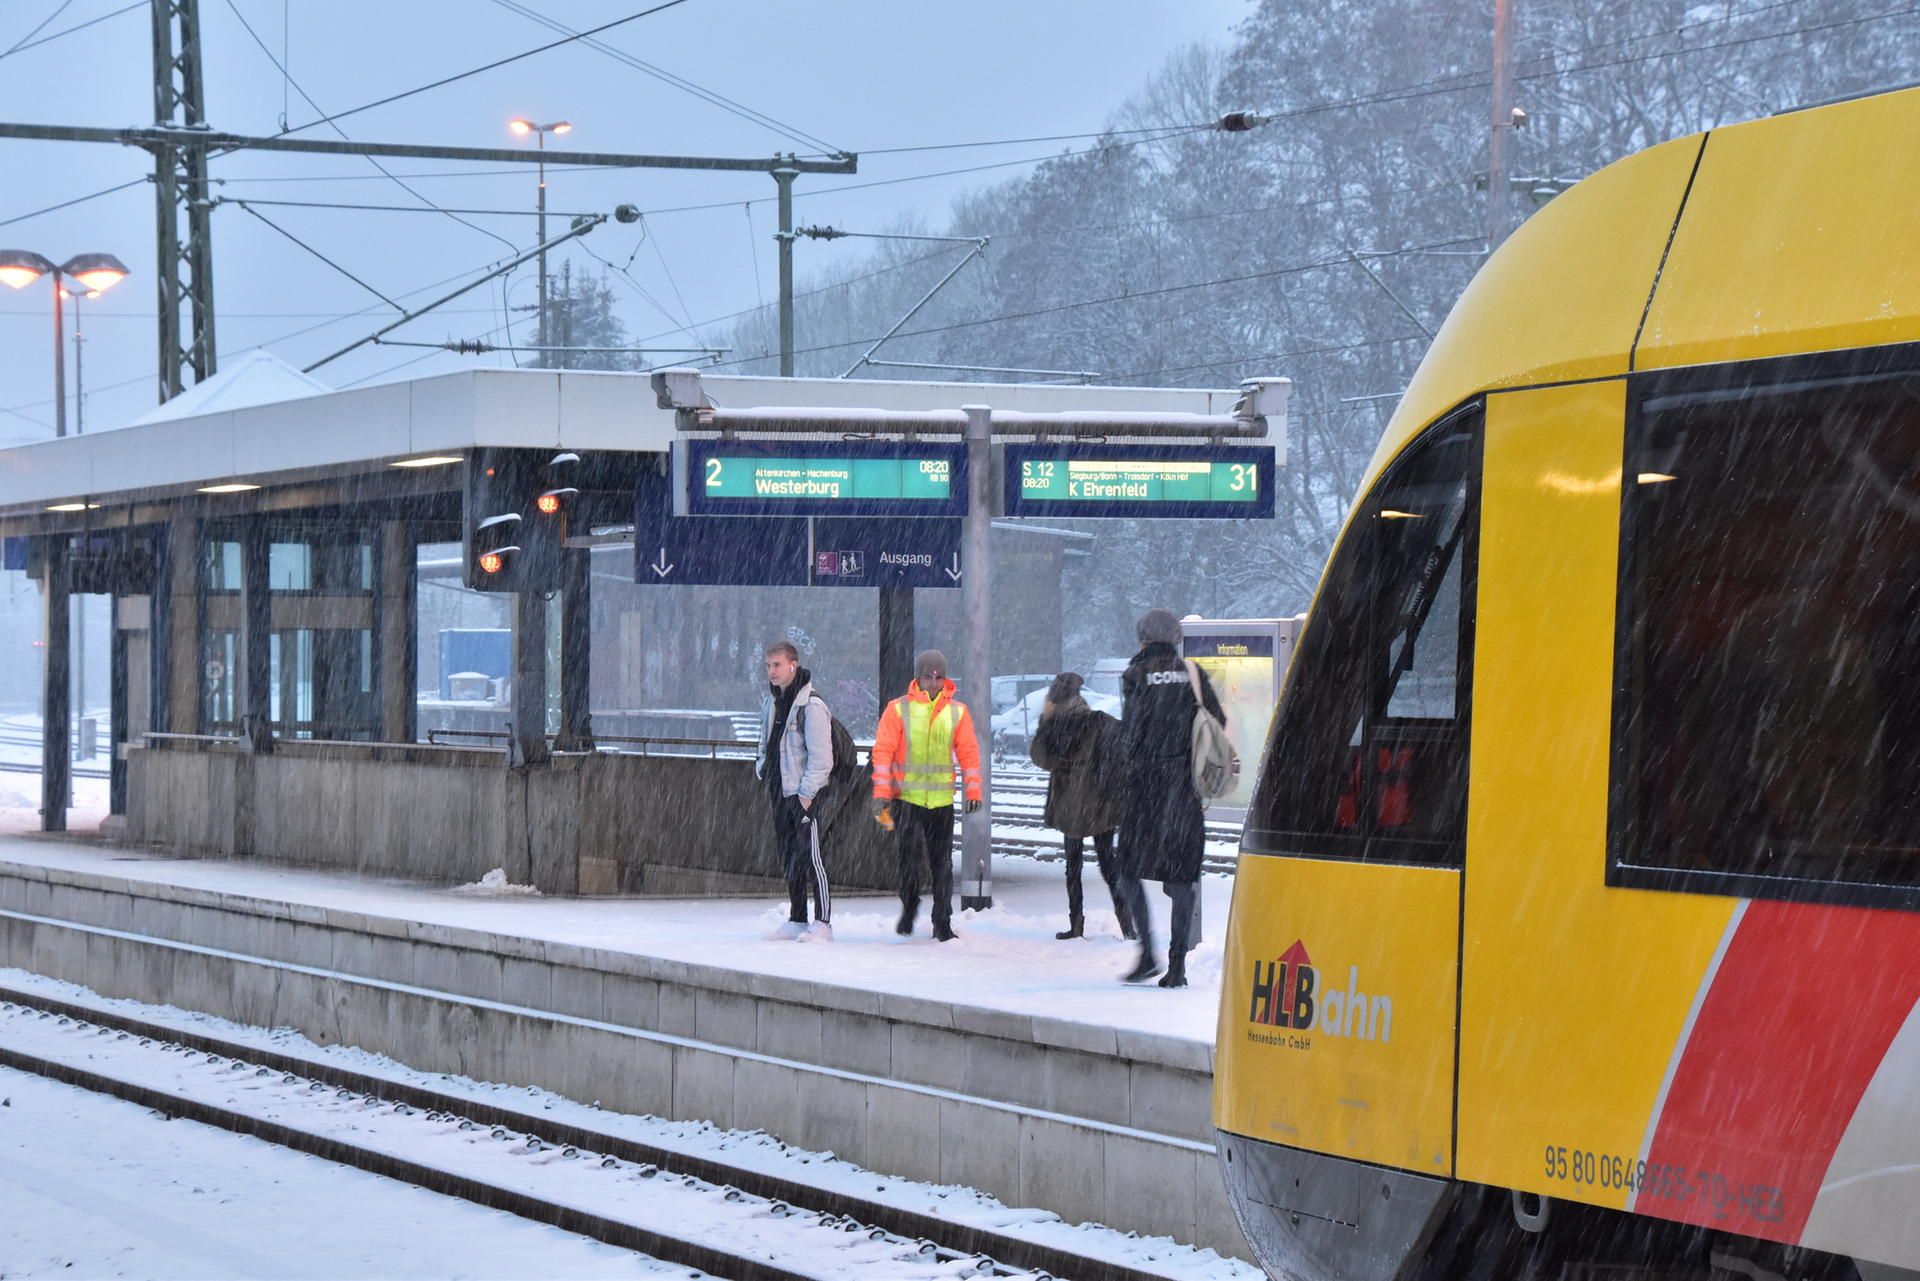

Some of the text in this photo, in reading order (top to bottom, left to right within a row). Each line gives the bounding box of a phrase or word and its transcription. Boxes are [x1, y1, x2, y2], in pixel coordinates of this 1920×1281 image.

[706, 459, 722, 486] 2
[755, 469, 801, 478] Altenkirchen
[919, 460, 949, 473] 08:20
[1022, 462, 1032, 476] S
[1037, 462, 1054, 476] 12
[1022, 478, 1049, 489] 08:20
[1124, 472, 1154, 481] Troisdorf
[1229, 464, 1257, 491] 31
[755, 479, 840, 498] Westerburg
[1069, 481, 1148, 497] K Ehrenfeld
[879, 551, 932, 567] Ausgang
[1216, 643, 1249, 656] Information
[1247, 1028, 1286, 1047] Hessenbahn
[1545, 1144, 1568, 1180] 95
[1572, 1149, 1596, 1185] 80
